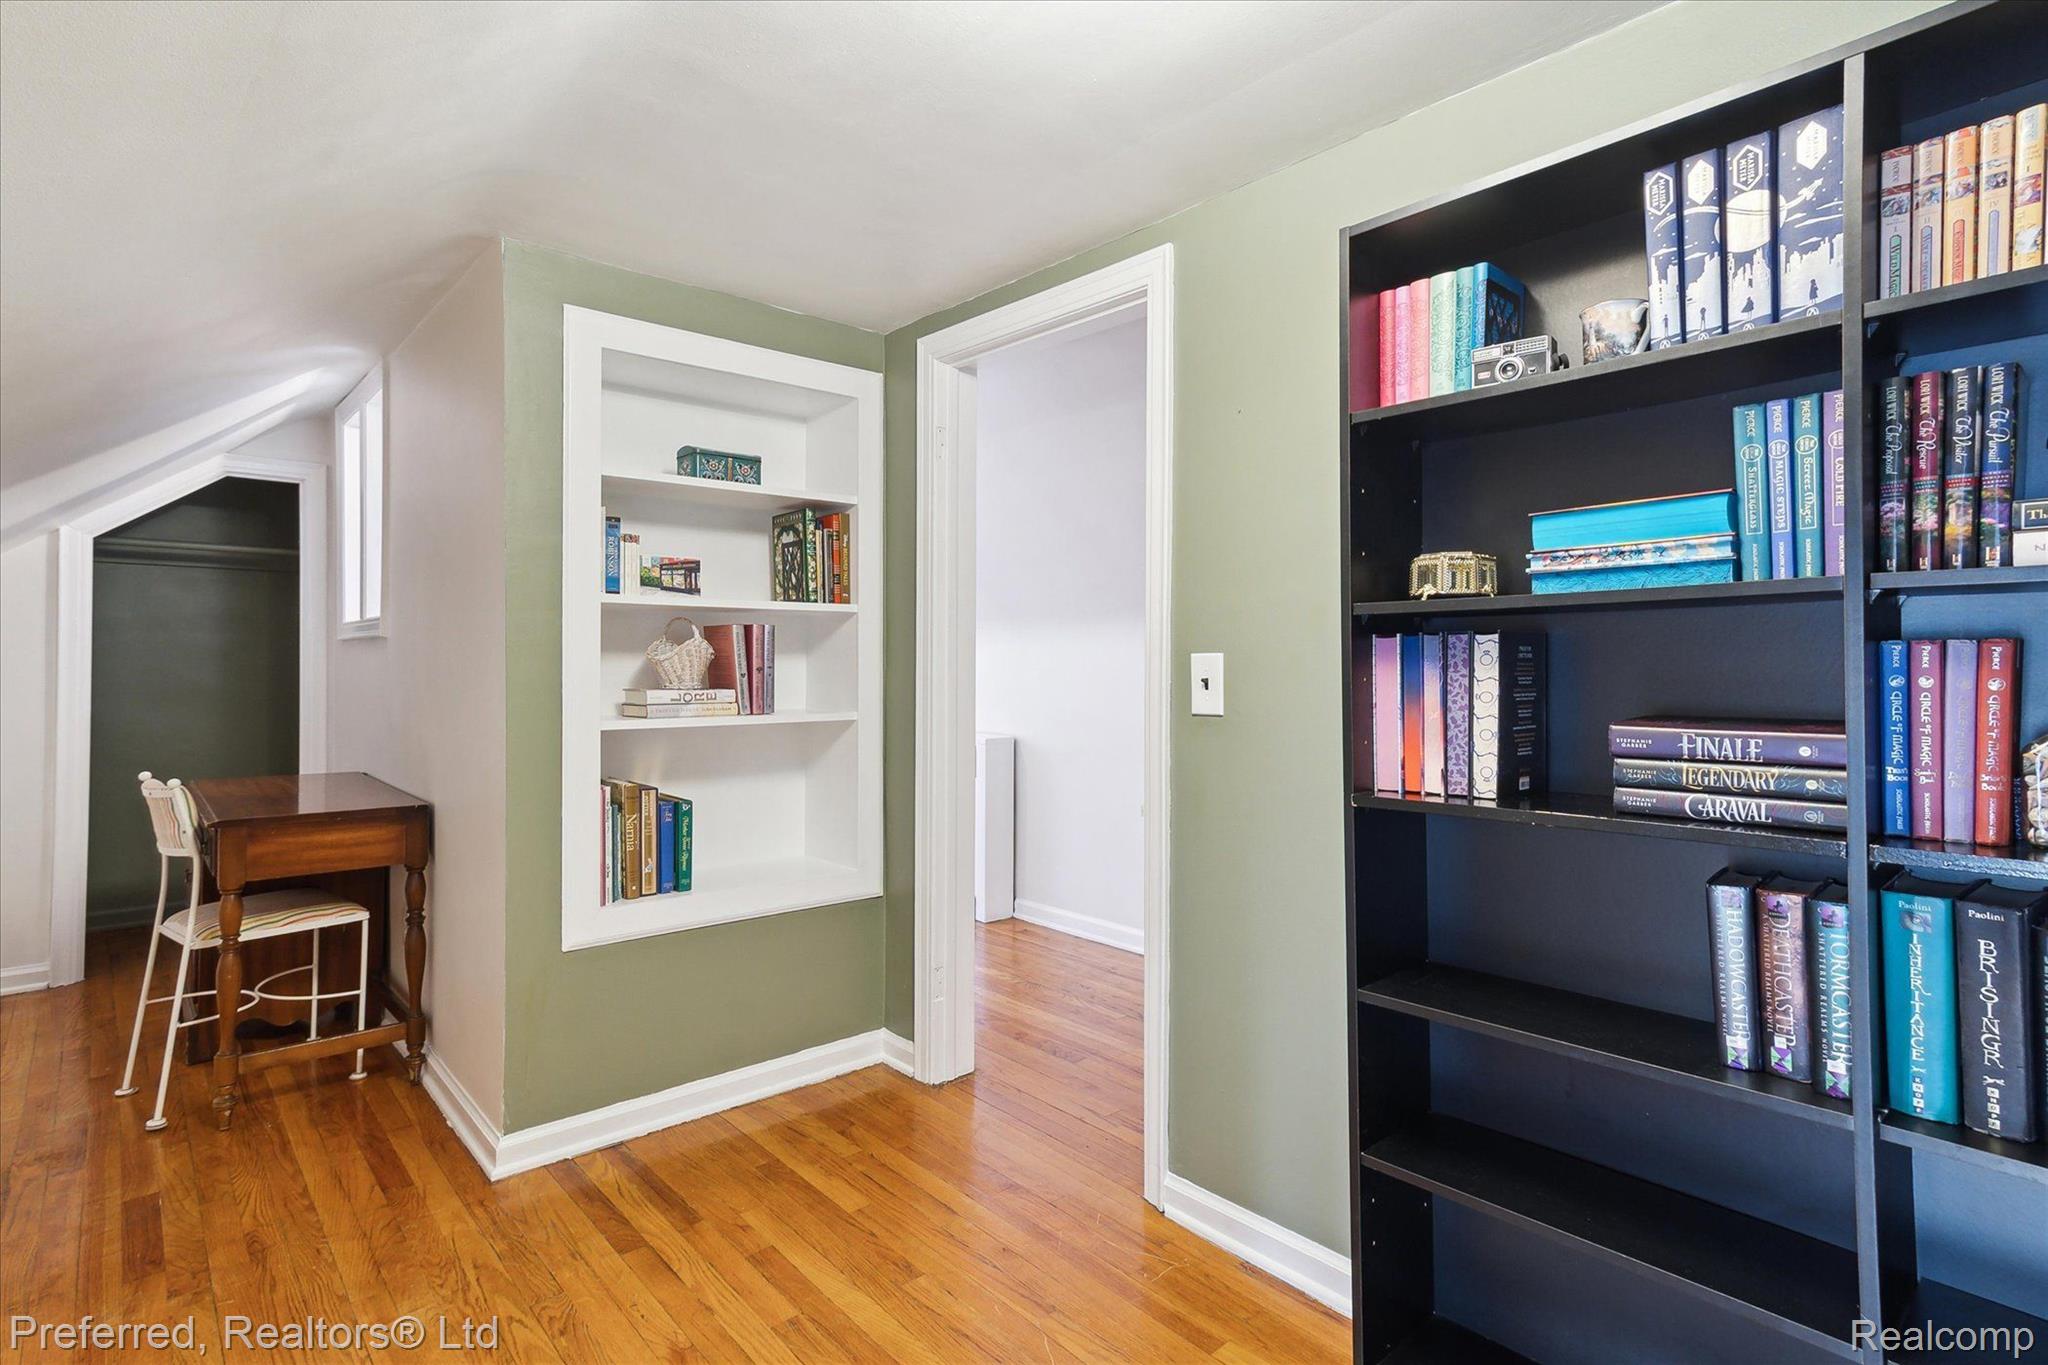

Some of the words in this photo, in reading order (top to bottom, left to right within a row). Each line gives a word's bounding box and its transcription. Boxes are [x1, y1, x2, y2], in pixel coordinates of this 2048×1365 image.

[1920, 379, 1931, 396] LORI
[1957, 375, 1969, 392] LORI
[1991, 366, 2004, 384] LORI
[1834, 393, 1844, 423] PIERCE
[1886, 386, 1897, 402] LORI
[1919, 396, 1931, 415] WICK
[1956, 392, 1968, 412] WICK
[1990, 384, 2004, 406] WICK
[1745, 410, 1756, 437] PIERCE
[1771, 405, 1783, 433] PIERCE
[1800, 400, 1811, 429] PIERCE
[1886, 402, 1897, 421] WICK
[1955, 415, 1972, 433] The
[1989, 407, 2010, 428] The
[1885, 423, 1903, 441] The
[1919, 418, 1936, 437] The
[1883, 441, 1903, 475] Proposal
[1916, 432, 1937, 470] Rescue
[1952, 428, 1973, 465] Visitor
[1985, 427, 2011, 463] Pursuit
[1773, 460, 1783, 494] MAGIC
[1776, 496, 1785, 528] STEPS
[1891, 645, 1902, 668] PIERCE
[1921, 645, 1931, 668] PIERCE
[1991, 646, 2002, 670] PIERCE
[670, 692, 717, 703] LORE
[1890, 690, 1903, 721] CIRCLE
[1919, 692, 1932, 724] CIRCLE
[1986, 694, 2000, 727] CIRCLE
[1615, 737, 1653, 745] STEPHANIE
[1677, 732, 1764, 763] FINALE
[1890, 734, 1904, 765] MAGIC
[1920, 735, 1933, 766] MAGIC
[1985, 740, 1999, 772] MAGIC
[1681, 764, 1779, 792] LEGENDARY
[1621, 795, 1657, 803] STEPHANIE
[1684, 793, 1773, 823] CARAVAL
[626, 813, 638, 852] Narnia
[1898, 900, 1932, 912] Paolini
[1967, 909, 2005, 922] Paolini
[1762, 922, 1771, 969] SHATTERED
[1726, 908, 1751, 1041] HADOWCASTER
[1818, 932, 1827, 989] SHATTERED
[1719, 973, 1727, 1008] REALMS
[1764, 971, 1773, 1002] REALMS
[1829, 932, 1853, 1066] TORMCASTER
[1908, 933, 1932, 1060] INHERITANCE
[1819, 995, 1828, 1032] REALMS
[1977, 938, 2005, 1069] BRISINGR
[1765, 1005, 1774, 1032] NOVEL
